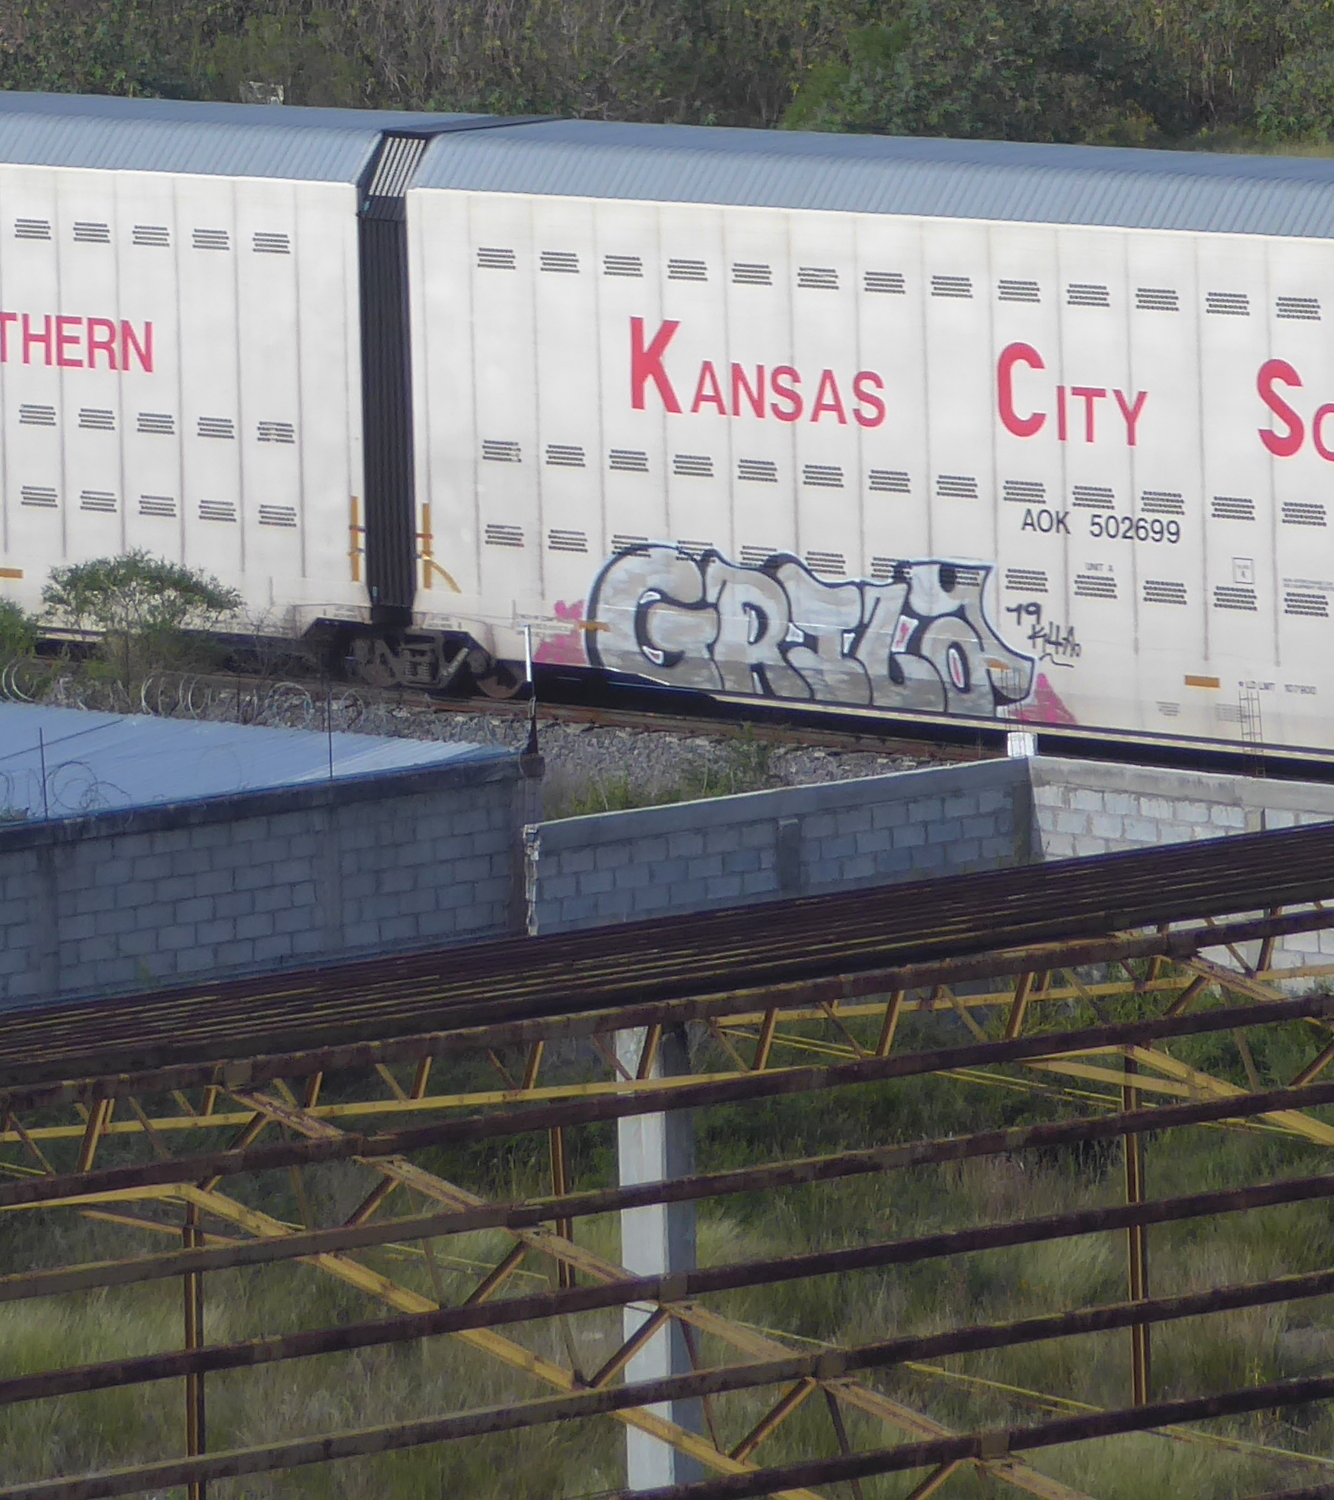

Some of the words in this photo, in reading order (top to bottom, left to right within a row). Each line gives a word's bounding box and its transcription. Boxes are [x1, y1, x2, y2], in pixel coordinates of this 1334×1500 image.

[629, 317, 887, 429] KANSAS
[996, 342, 1148, 447] CITY
[1021, 508, 1071, 534] AOK
[1089, 514, 1181, 544] 502699
